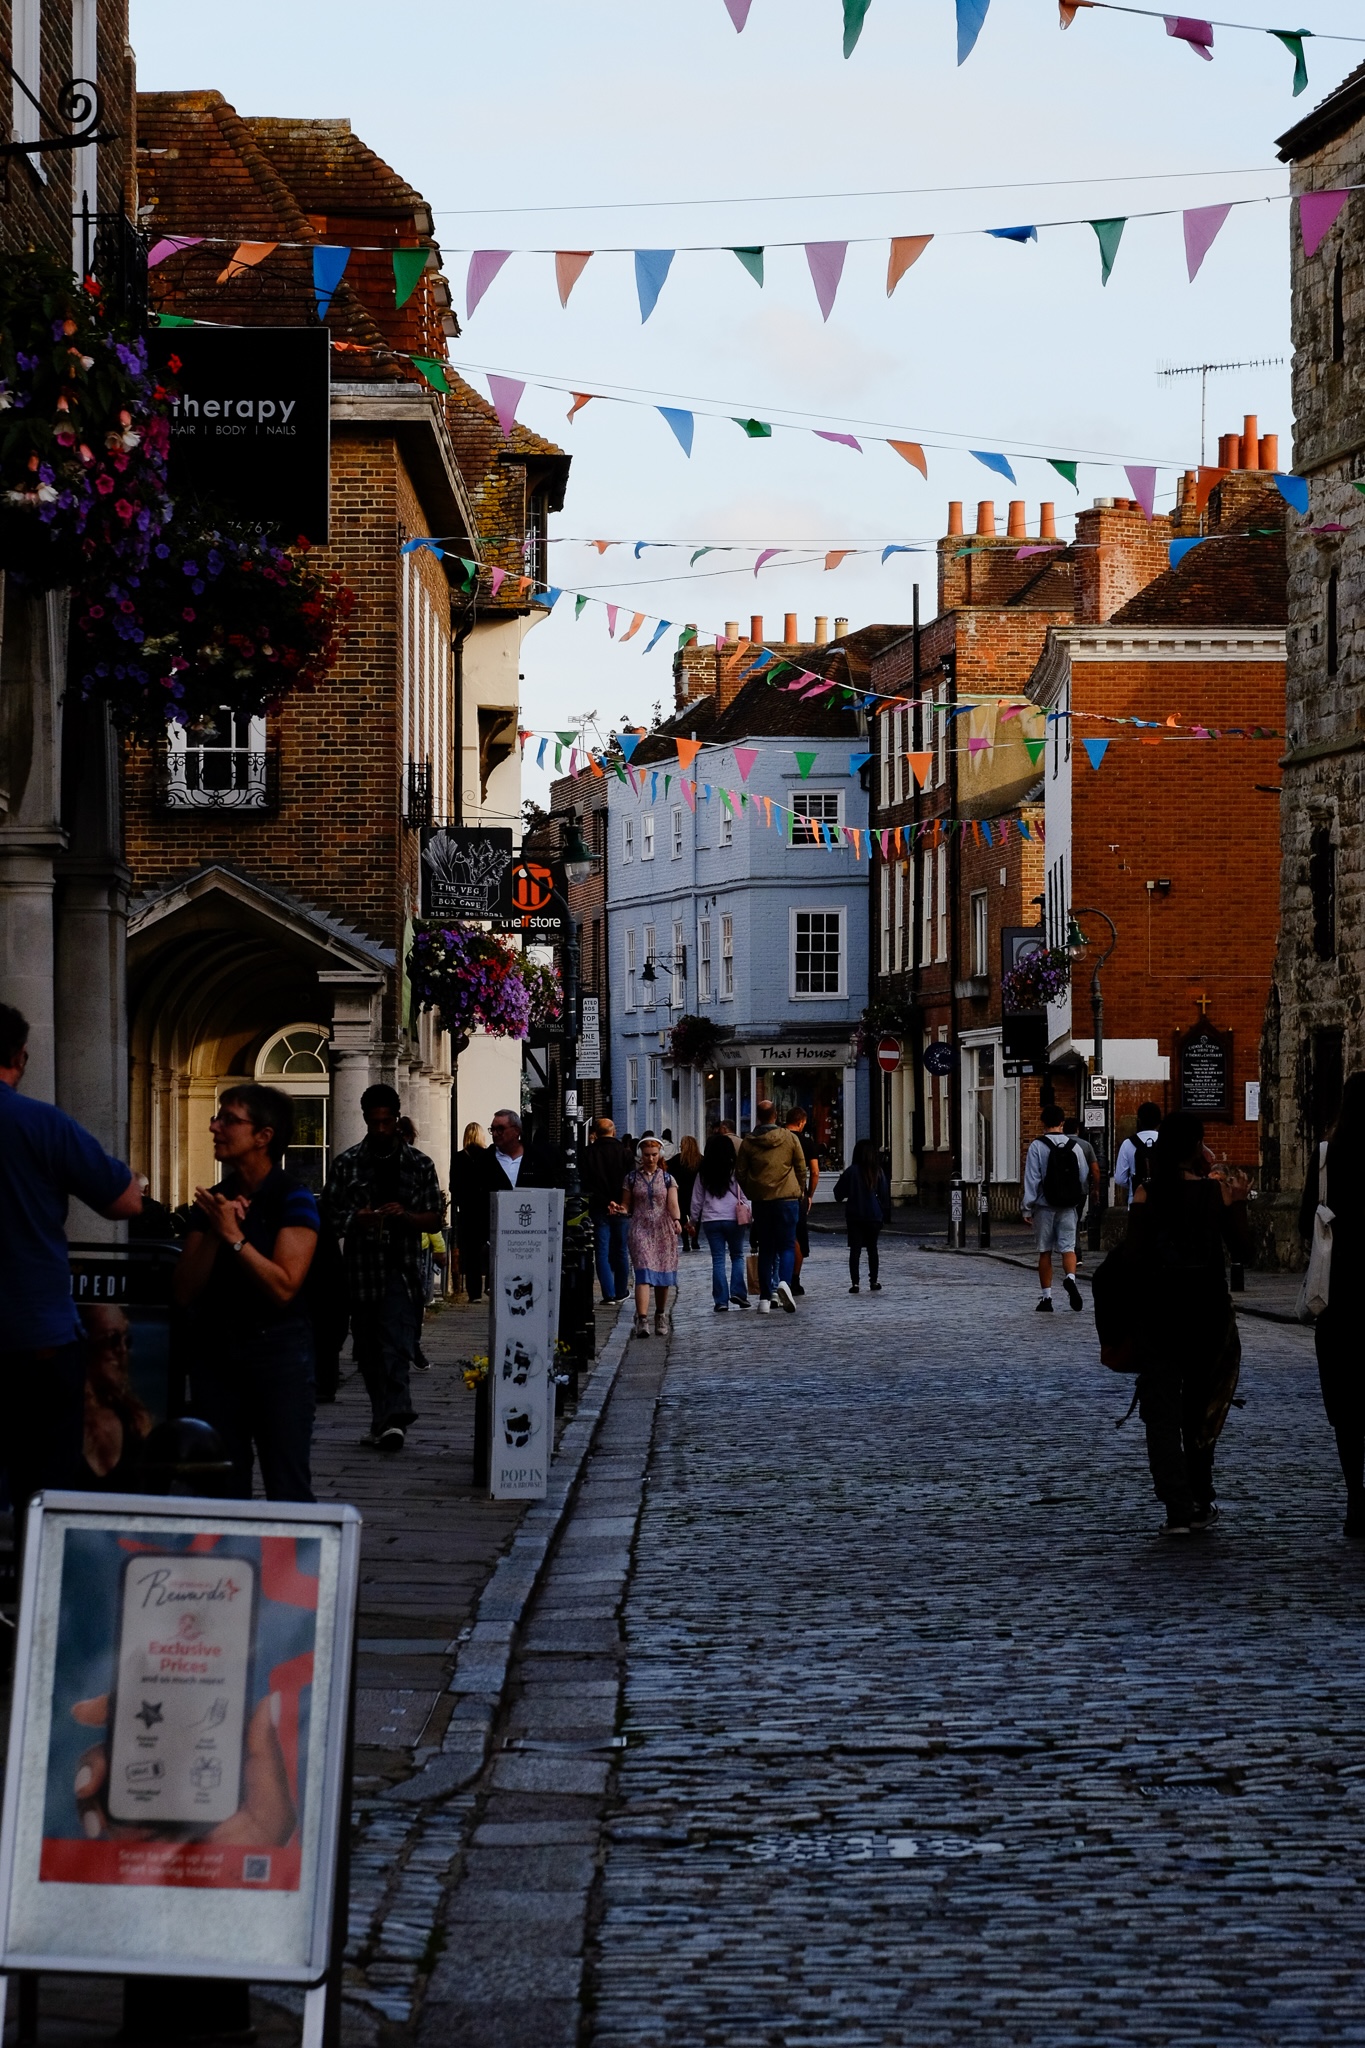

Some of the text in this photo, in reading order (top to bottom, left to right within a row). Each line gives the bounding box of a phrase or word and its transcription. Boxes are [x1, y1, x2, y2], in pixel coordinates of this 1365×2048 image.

[172, 393, 296, 424] therapy
[170, 425, 297, 435] HAIR BODY NAILS
[437, 883, 480, 895] THE VEG
[430, 910, 504, 918] simply seasonal
[760, 1046, 837, 1059] Thai House
[501, 1468, 543, 1481] POP IN
[137, 1568, 227, 1608] Rewards
[148, 1641, 223, 1656] Exclusive
[160, 1657, 208, 1673] Prices
